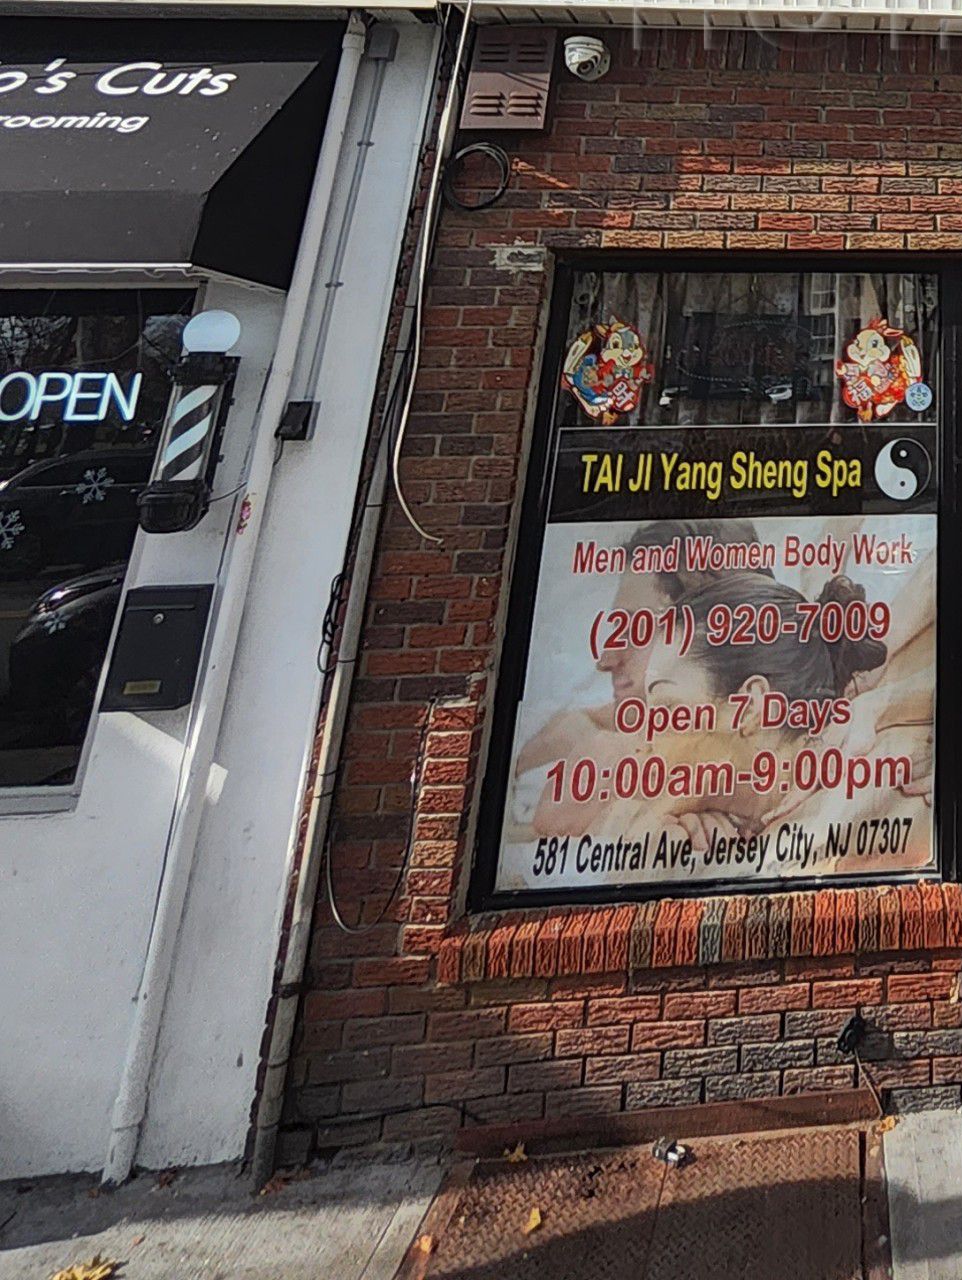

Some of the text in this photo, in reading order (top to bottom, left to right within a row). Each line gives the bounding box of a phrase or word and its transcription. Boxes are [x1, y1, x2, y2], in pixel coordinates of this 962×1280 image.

[0, 58, 238, 96] o's Cuts
[0, 371, 143, 421] OPEN
[581, 450, 862, 500] TAI JI Yang Sheng Spa
[572, 533, 914, 575] Men and Women Body Work
[589, 601, 891, 660] (201) 920-7009
[615, 692, 852, 742] Open 7 Days
[545, 747, 912, 803] 10:00am-9:00pm
[532, 817, 913, 877] 581 Central Ave, Jersey City, NJ 07307
